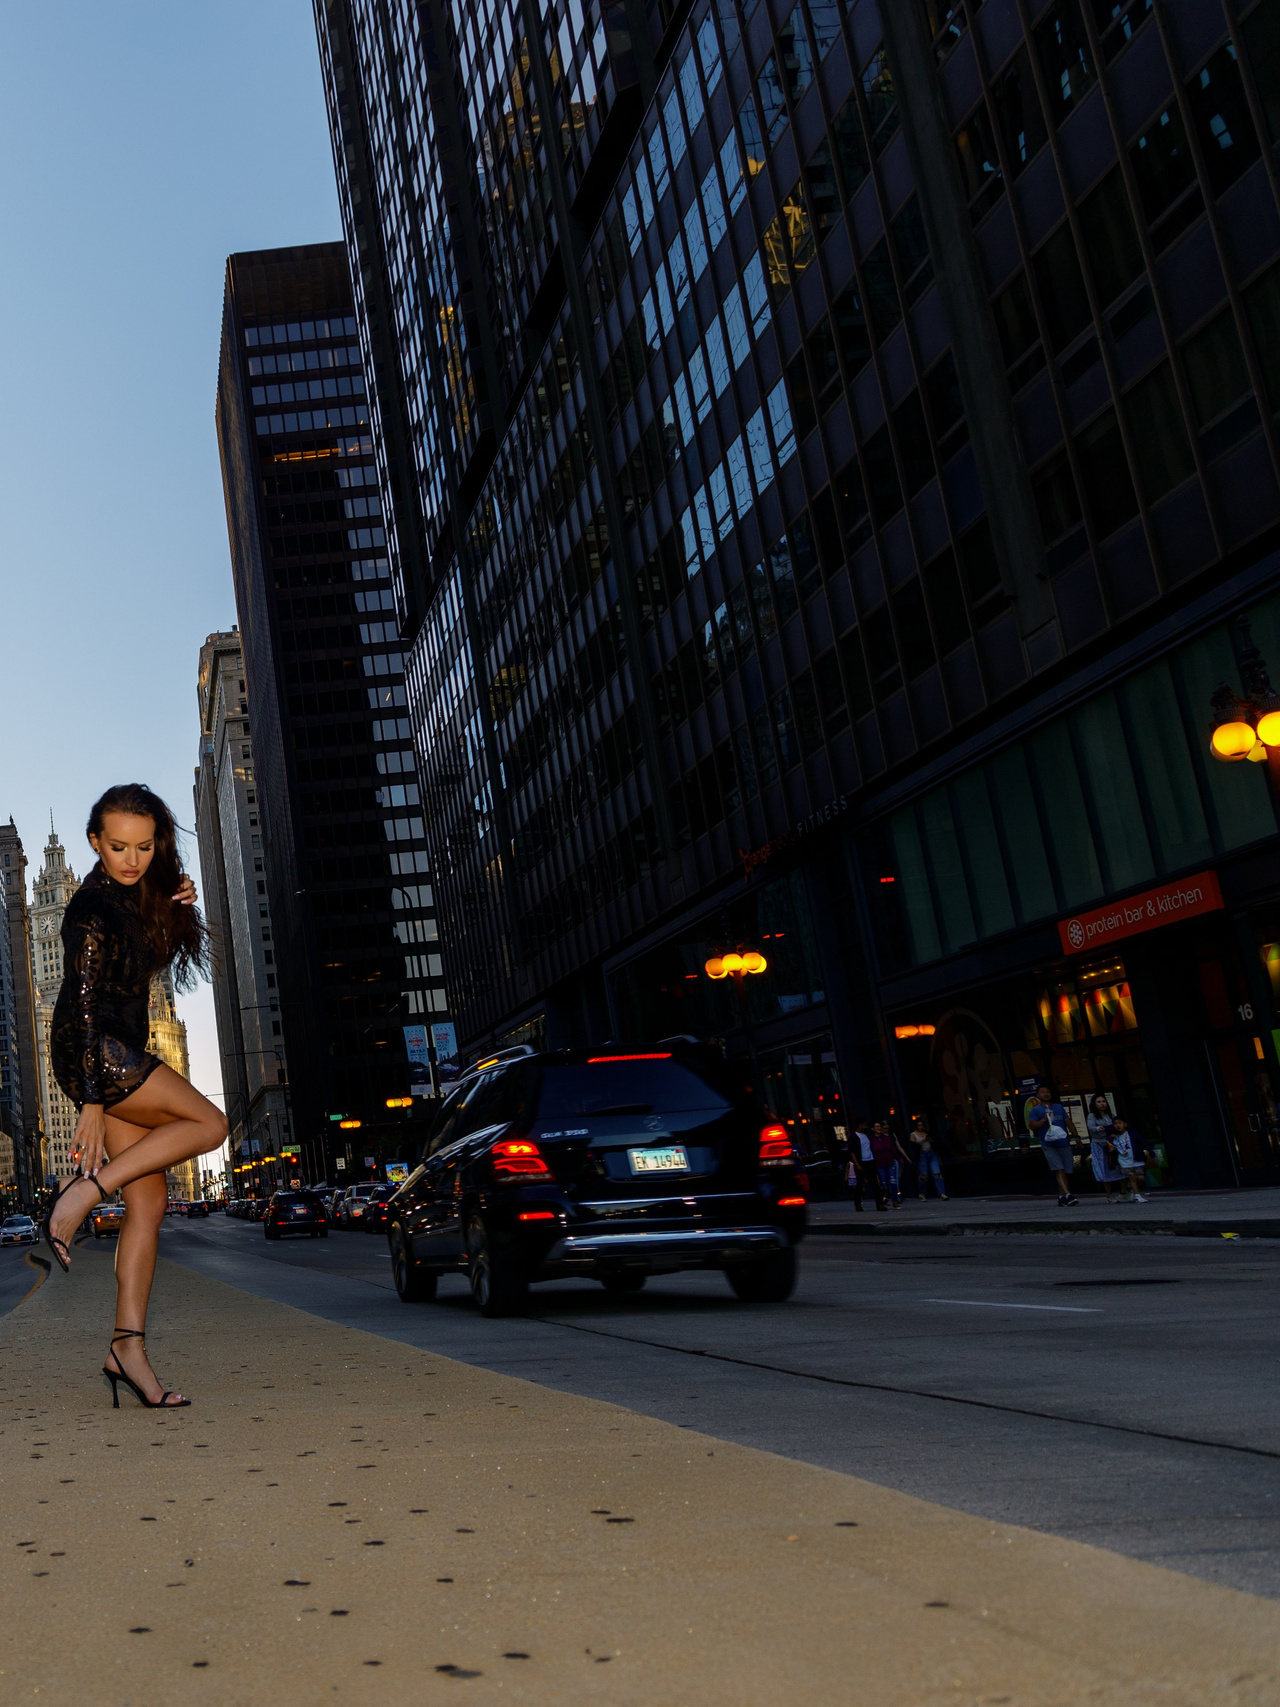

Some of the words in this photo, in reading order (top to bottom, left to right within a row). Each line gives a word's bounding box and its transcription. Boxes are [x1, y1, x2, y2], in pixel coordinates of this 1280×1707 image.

[796, 795, 848, 838] FITNESS
[1085, 911, 1124, 939] protein
[1124, 906, 1145, 924] bar
[1146, 900, 1157, 917] &
[1157, 887, 1203, 914] kitchen
[1237, 1003, 1254, 1021] 16
[635, 1156, 649, 1169] EK
[653, 1154, 686, 1168] 14944
